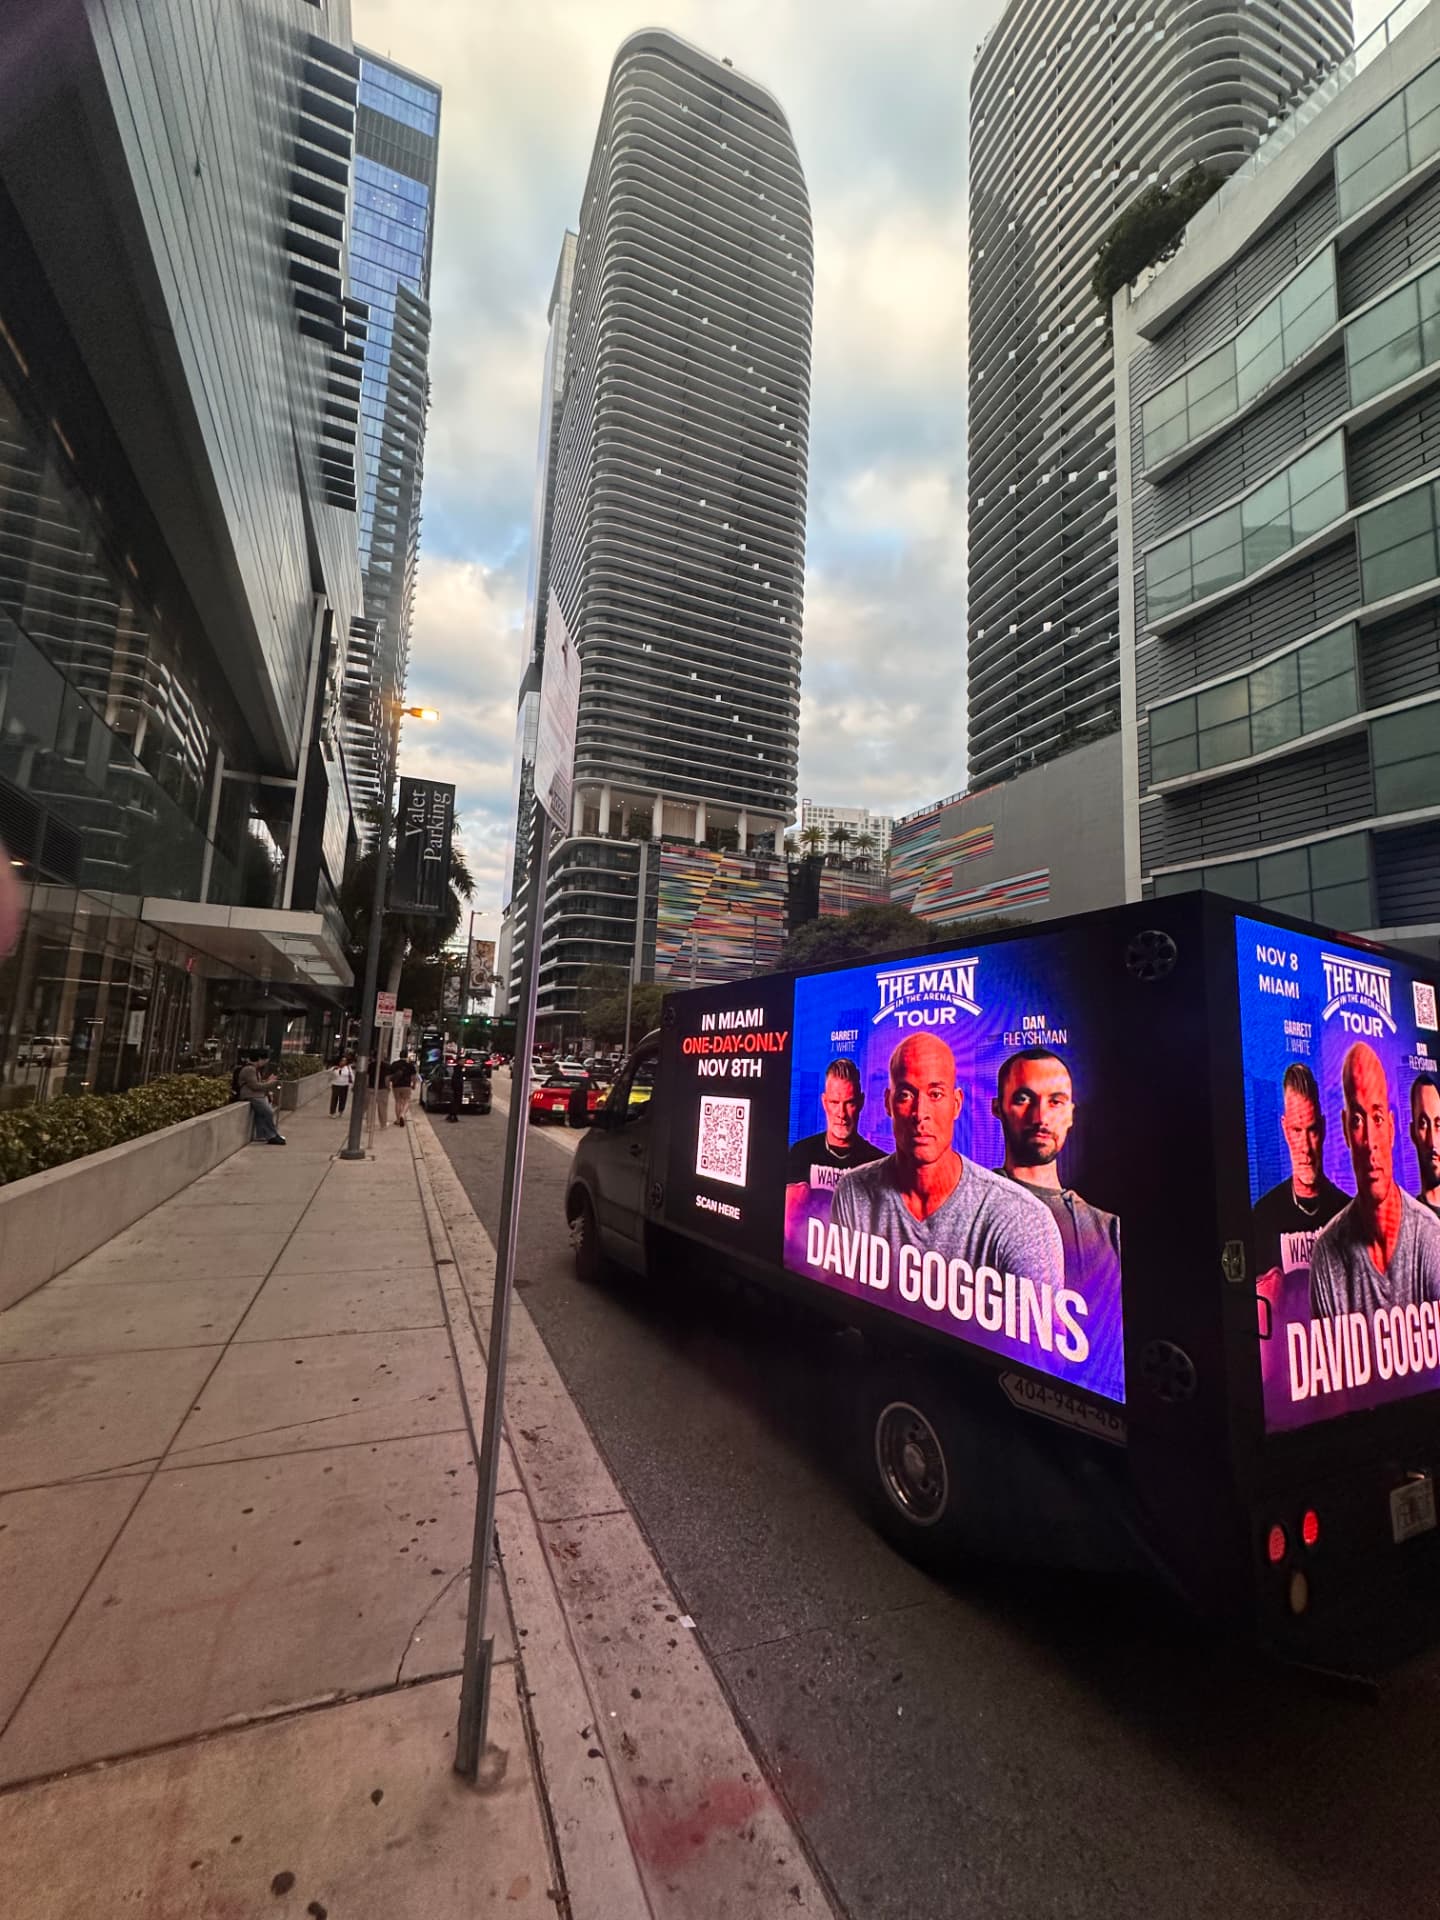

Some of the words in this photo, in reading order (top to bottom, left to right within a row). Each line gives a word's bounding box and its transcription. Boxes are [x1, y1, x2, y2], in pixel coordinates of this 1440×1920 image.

[405, 789, 426, 836] Valet
[423, 790, 453, 862] Parking
[1256, 944, 1286, 969] NOV
[1290, 953, 1298, 971] 8
[877, 975, 916, 1010] THE
[918, 965, 975, 1001] MAN
[1259, 974, 1300, 999] MIAMI
[1323, 962, 1353, 1001] THE
[1354, 970, 1391, 1016] MAN
[895, 998, 904, 1008] IN
[906, 993, 921, 1004] THE
[923, 992, 952, 1003] ARENA
[701, 1013, 716, 1032] IN
[718, 1007, 764, 1030] MIAMI
[894, 1006, 957, 1028] TOUR
[1022, 1014, 1045, 1030] DAN
[1340, 1010, 1384, 1038] TOUR
[682, 1031, 788, 1054] ONE-DAY-ONLY
[831, 1029, 859, 1041] GARRETT
[1003, 1028, 1068, 1046] FLEYSHMAN
[697, 1058, 729, 1077] NOV
[730, 1058, 762, 1078] 8TH
[695, 1194, 718, 1212] SCAN
[717, 1202, 741, 1220] HERE
[806, 1216, 890, 1290] DAVID
[899, 1244, 1090, 1363] GOGGINS
[1286, 1312, 1371, 1402] DAVID
[1374, 1300, 1440, 1380] GOGGI
